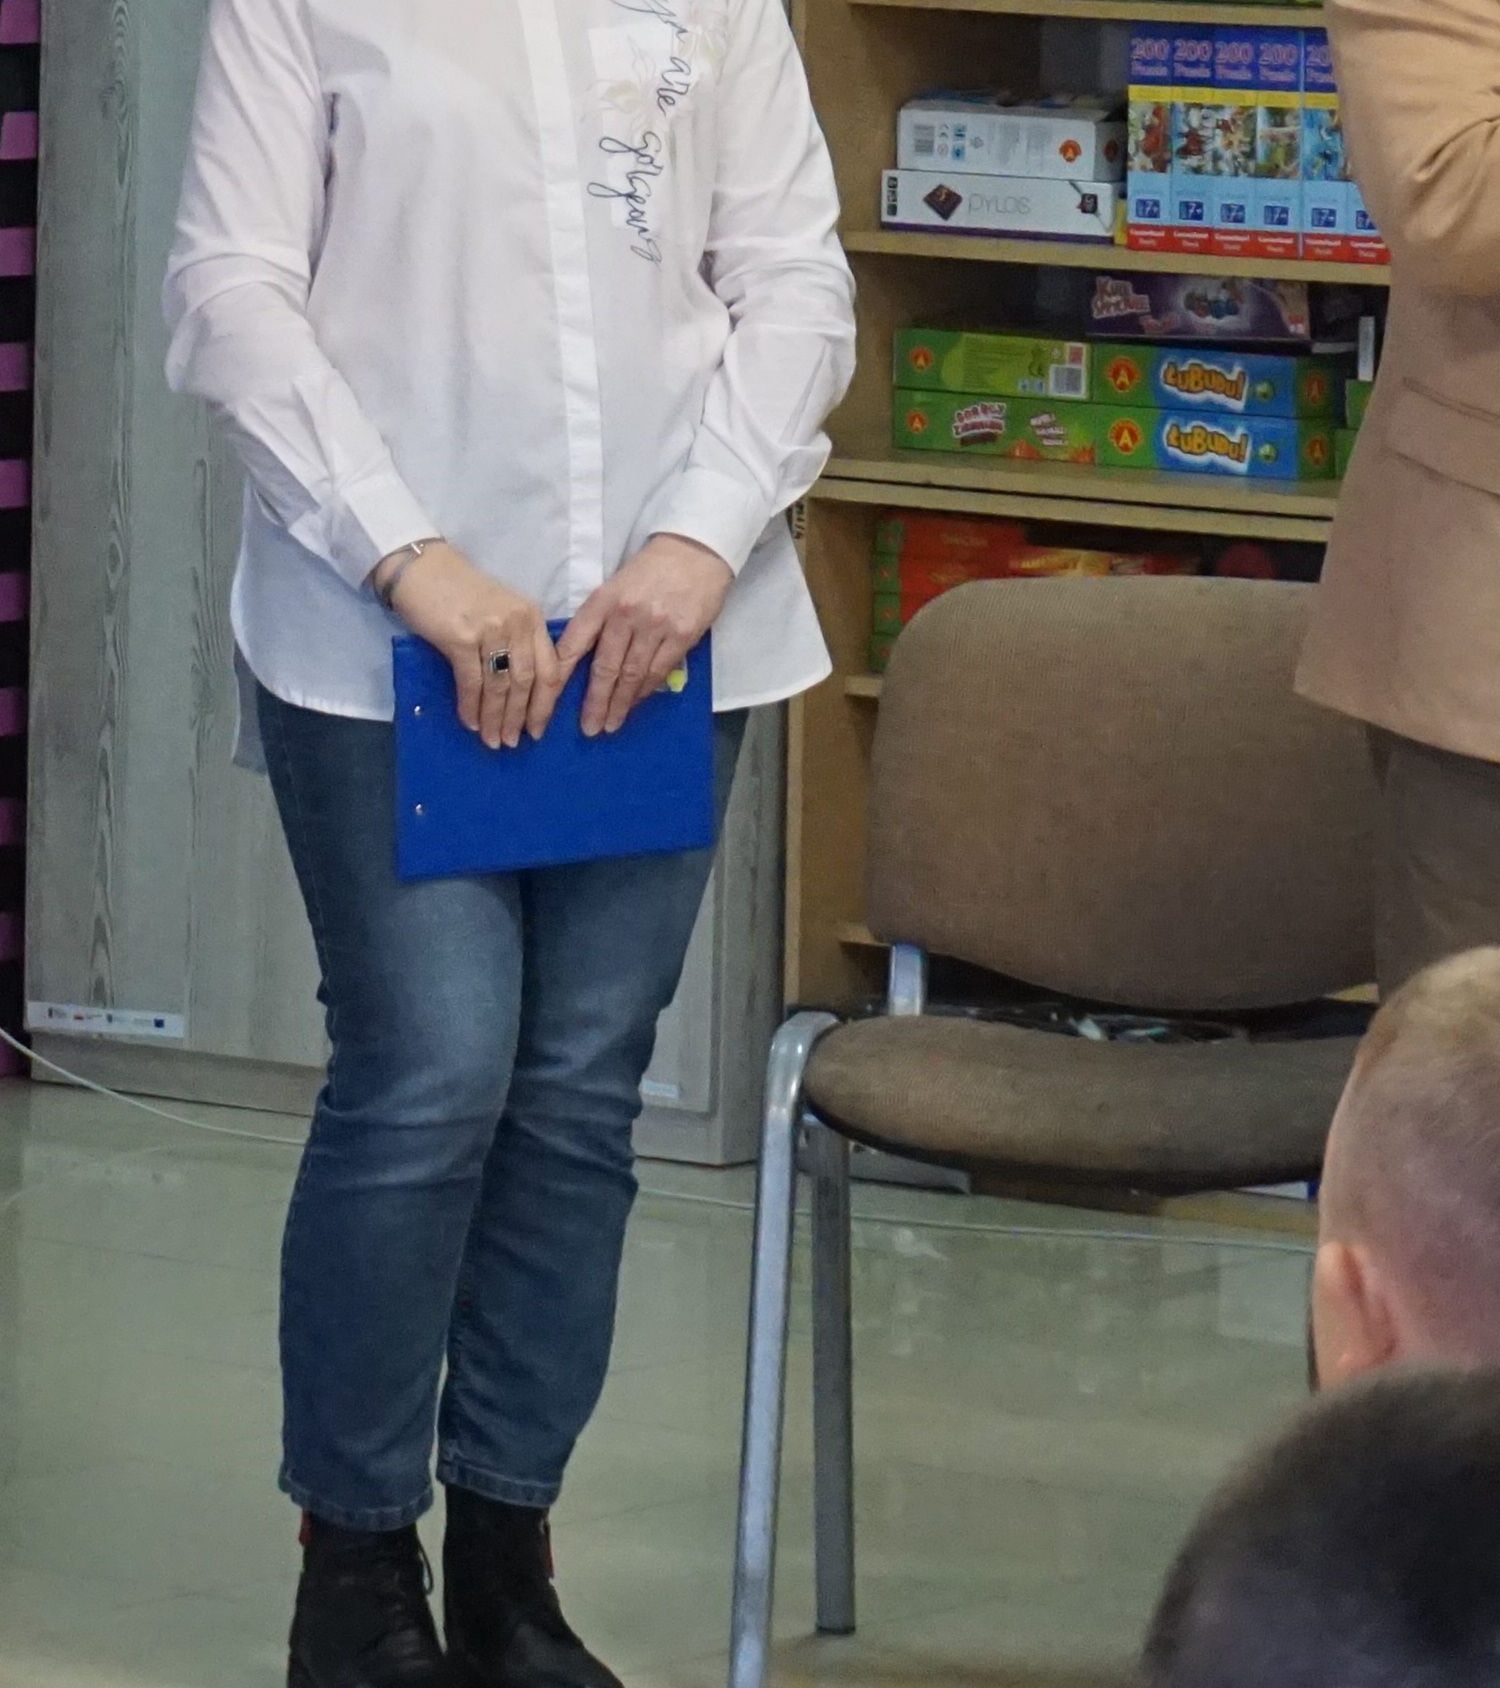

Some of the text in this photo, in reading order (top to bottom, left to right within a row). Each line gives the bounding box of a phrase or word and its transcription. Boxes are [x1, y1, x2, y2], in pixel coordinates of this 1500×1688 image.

[1130, 37, 1170, 60] 200
[1173, 39, 1213, 62] 200
[1215, 42, 1254, 64] 200
[1259, 43, 1299, 65] 200
[1306, 44, 1331, 67] 20
